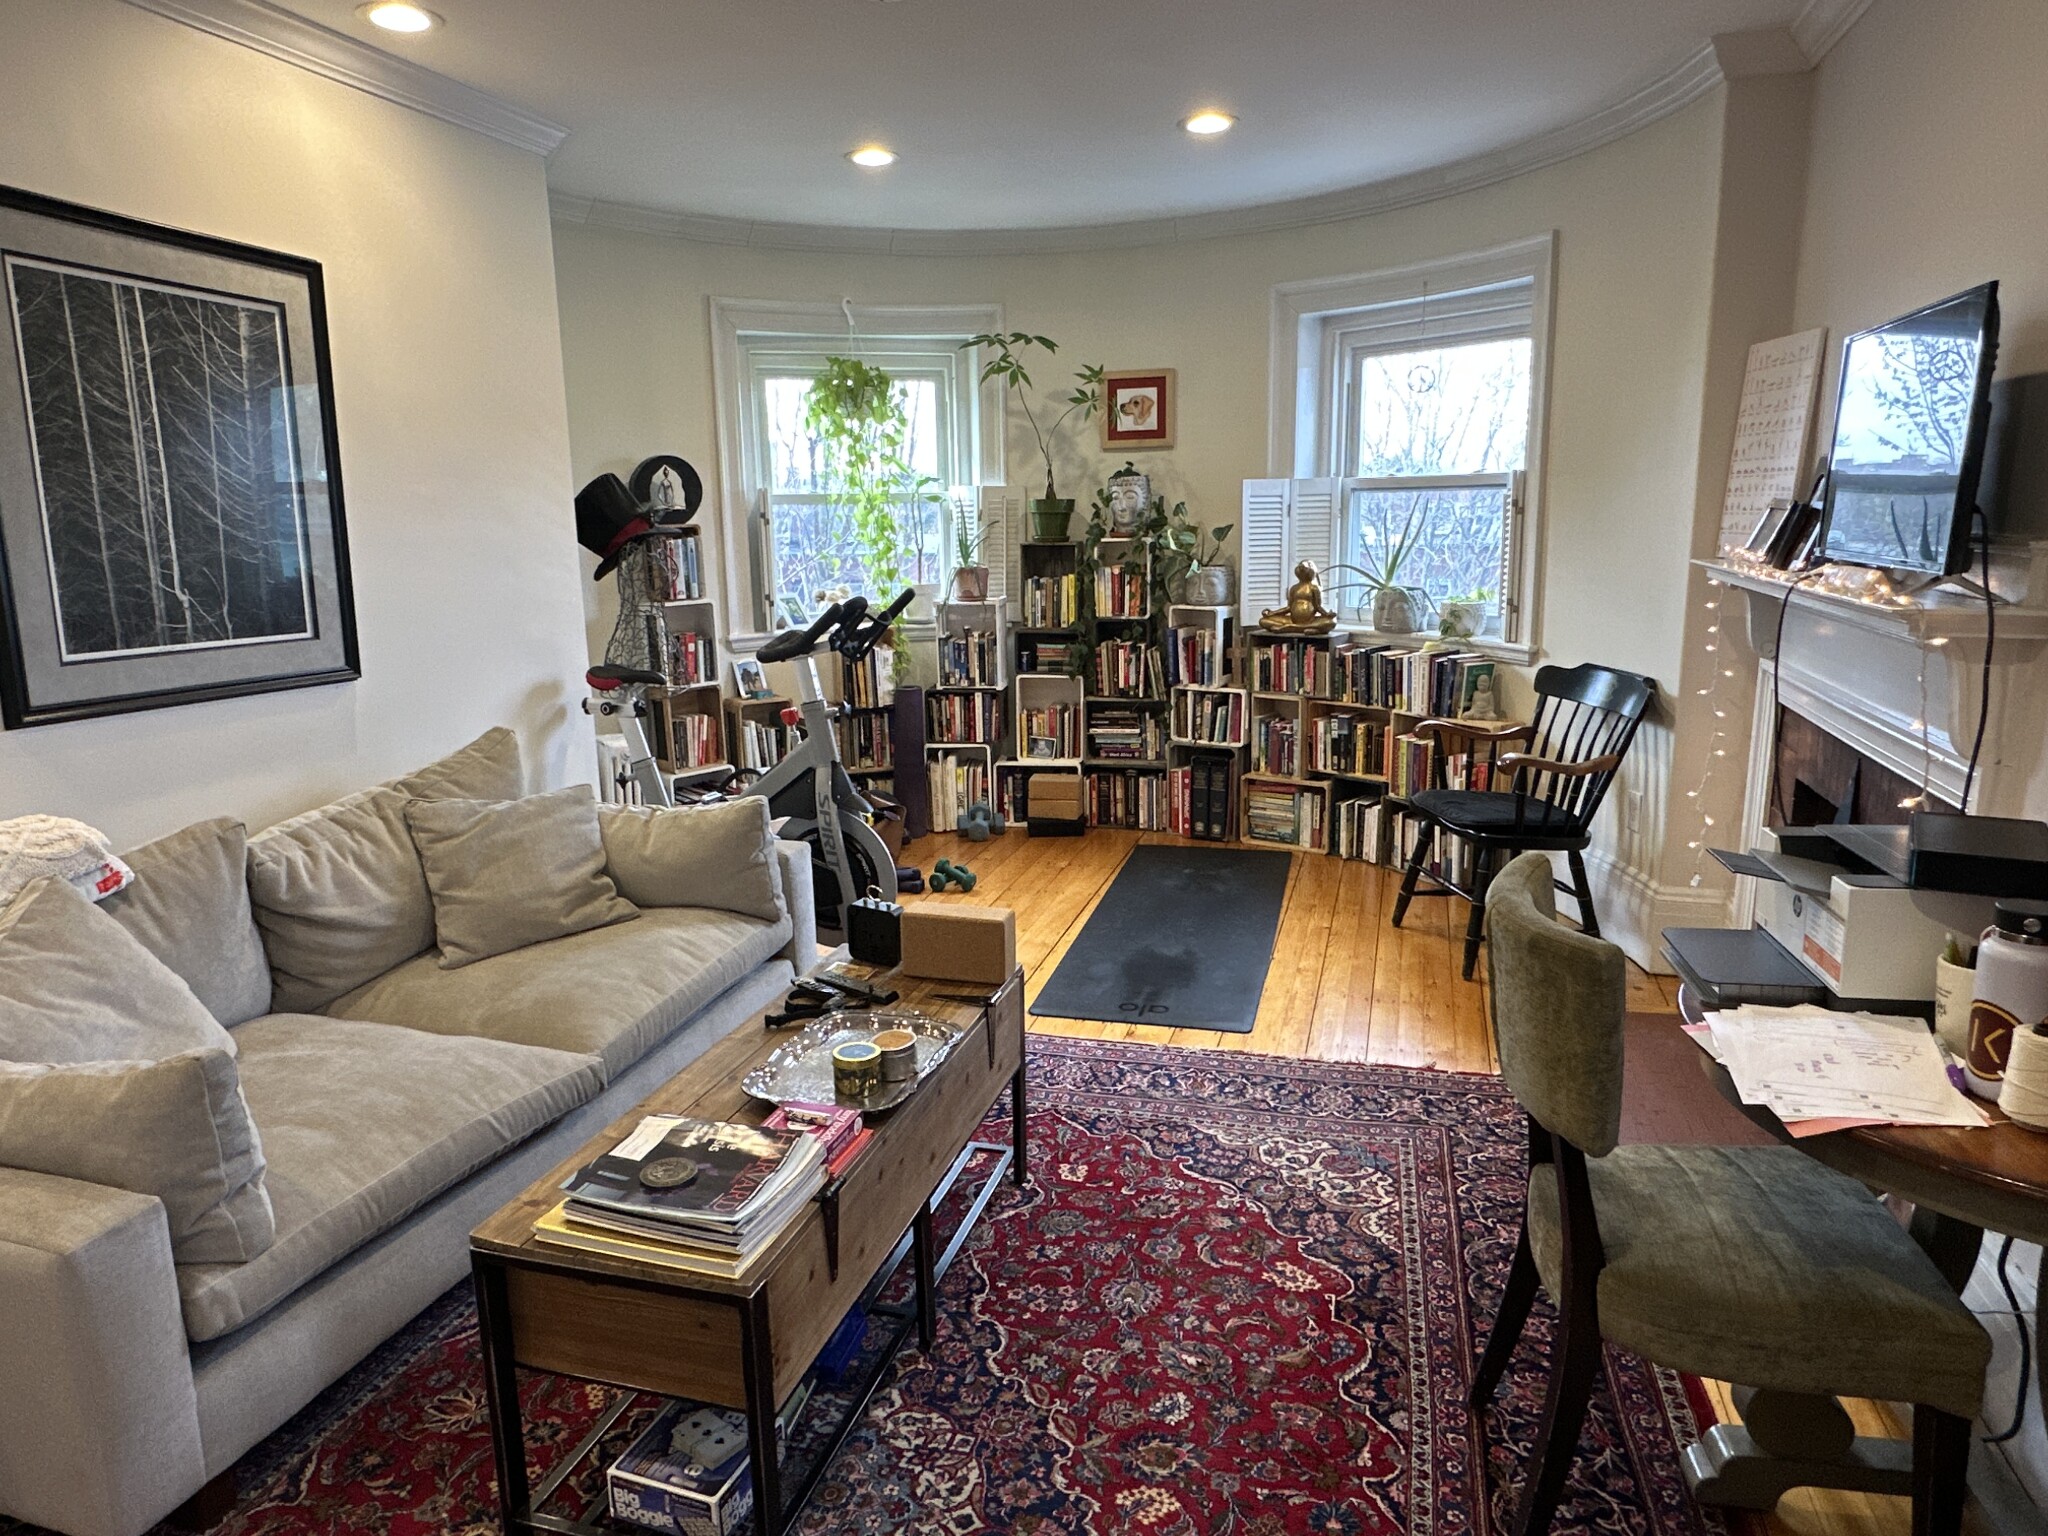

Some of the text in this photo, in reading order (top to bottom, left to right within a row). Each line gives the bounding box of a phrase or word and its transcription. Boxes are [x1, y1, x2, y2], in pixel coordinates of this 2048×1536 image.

[819, 792, 841, 873] SPIRIT
[1118, 1002, 1170, 1017] alo
[712, 1130, 798, 1212] HARVARD
[613, 1486, 641, 1509] Big
[615, 1502, 674, 1528] Boggle
